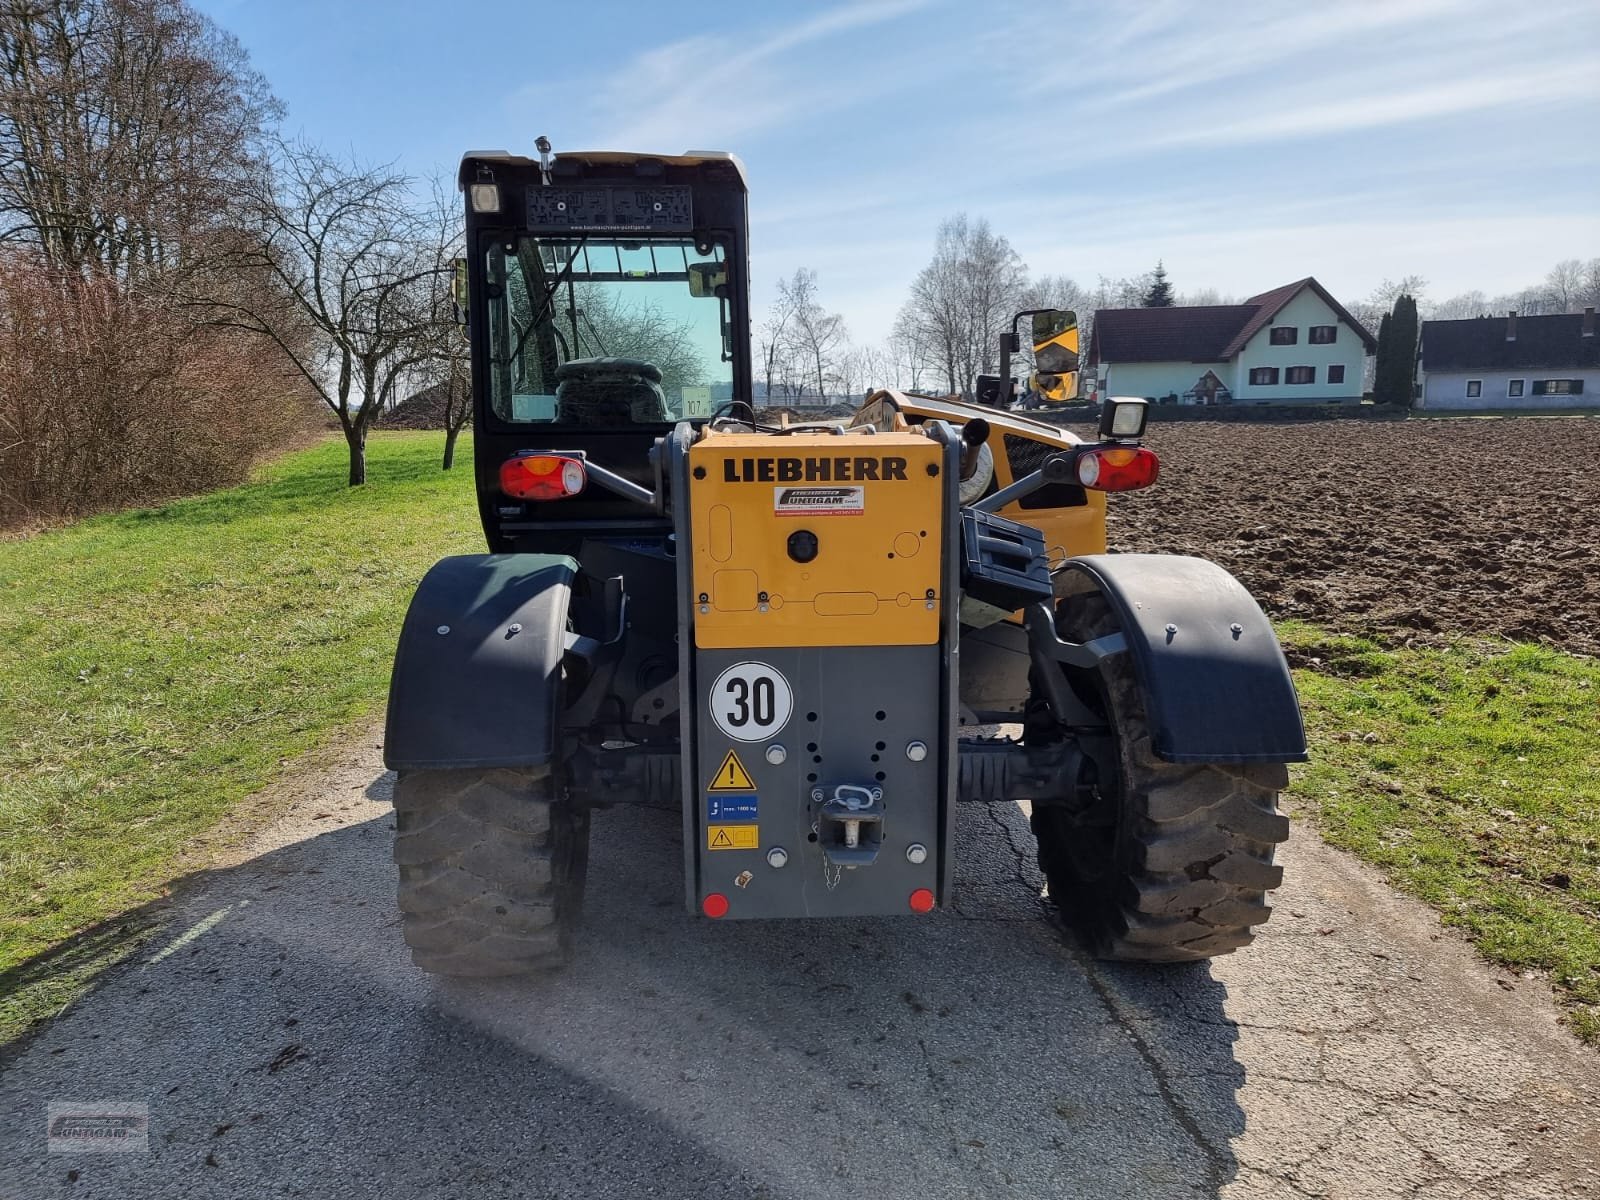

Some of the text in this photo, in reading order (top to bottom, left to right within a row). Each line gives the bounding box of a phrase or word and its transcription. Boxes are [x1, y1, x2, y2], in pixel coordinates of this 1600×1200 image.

[687, 400, 701, 416] 107
[724, 458, 907, 482] LIEBHERR
[726, 676, 775, 727] 30
